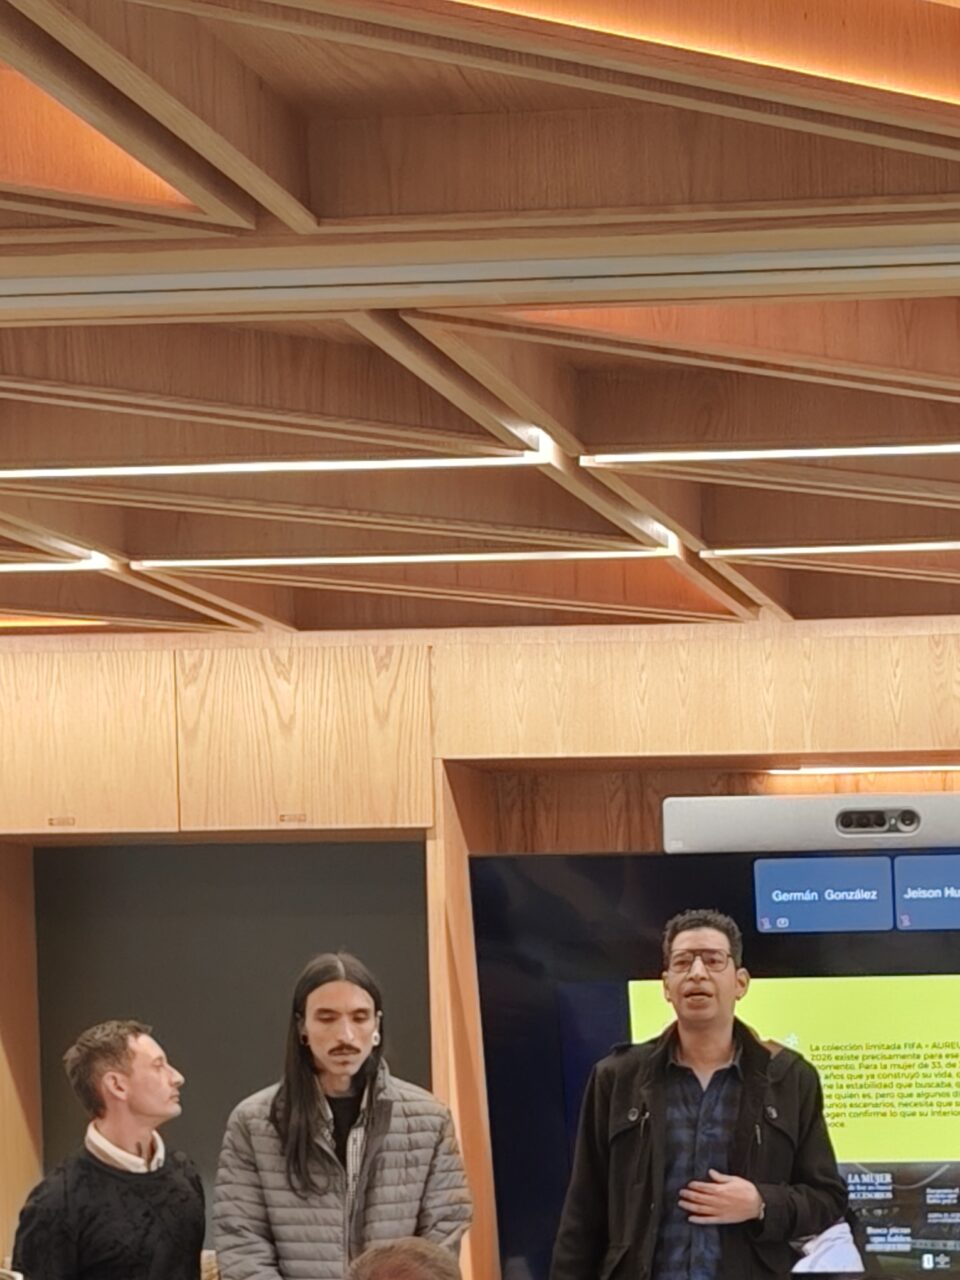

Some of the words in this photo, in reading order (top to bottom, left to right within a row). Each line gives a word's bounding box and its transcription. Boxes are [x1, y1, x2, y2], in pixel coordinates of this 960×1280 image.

[772, 889, 818, 902] Germán
[825, 888, 877, 900] González
[809, 1044, 820, 1052] La
[822, 1043, 863, 1051] colección
[865, 1043, 901, 1051] limitada
[862, 1053, 921, 1061] precisamente
[890, 1063, 916, 1072] mujer
[847, 1073, 863, 1081] que
[866, 1073, 875, 1081] ya
[836, 1082, 844, 1090] la
[846, 1081, 893, 1090] estabilidad
[876, 1092, 895, 1100] pero
[897, 1092, 914, 1100] que
[916, 1090, 951, 1099] algunos
[898, 1100, 933, 1108] necesita
[848, 1110, 887, 1118] confirme
